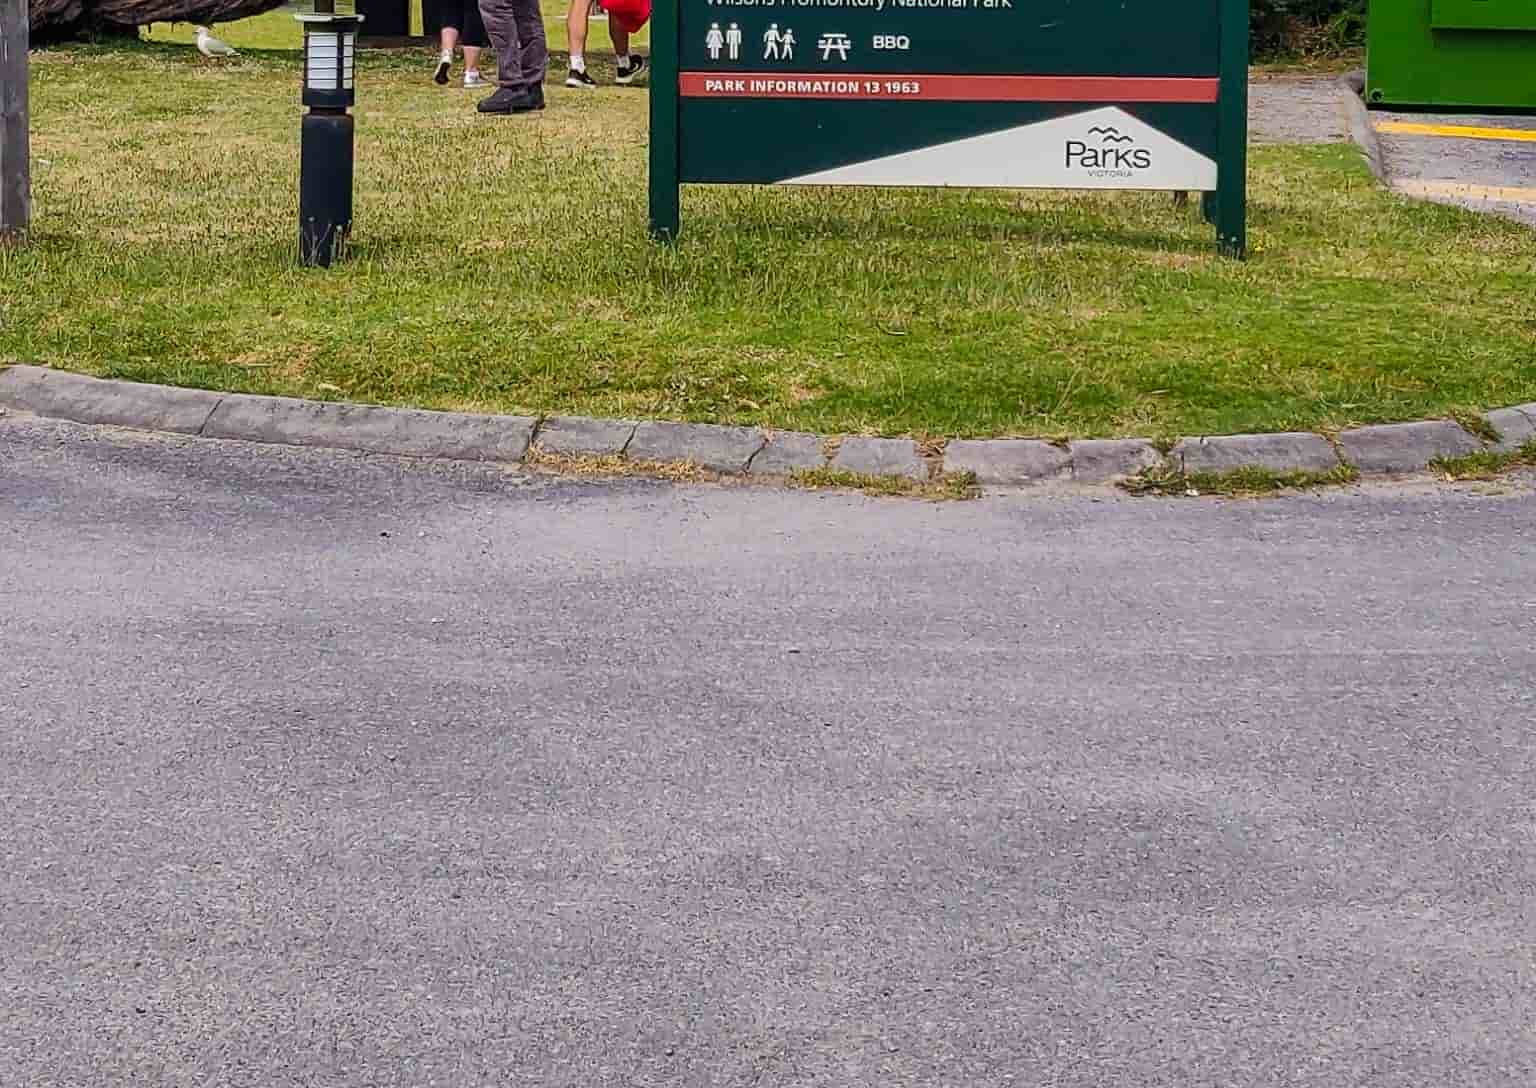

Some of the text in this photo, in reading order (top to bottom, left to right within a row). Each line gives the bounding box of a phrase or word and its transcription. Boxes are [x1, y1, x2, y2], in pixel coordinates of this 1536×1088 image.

[872, 34, 910, 50] BBQ
[705, 79, 920, 94] PARK INFORMATION 13 1963
[1065, 140, 1151, 169] Parks
